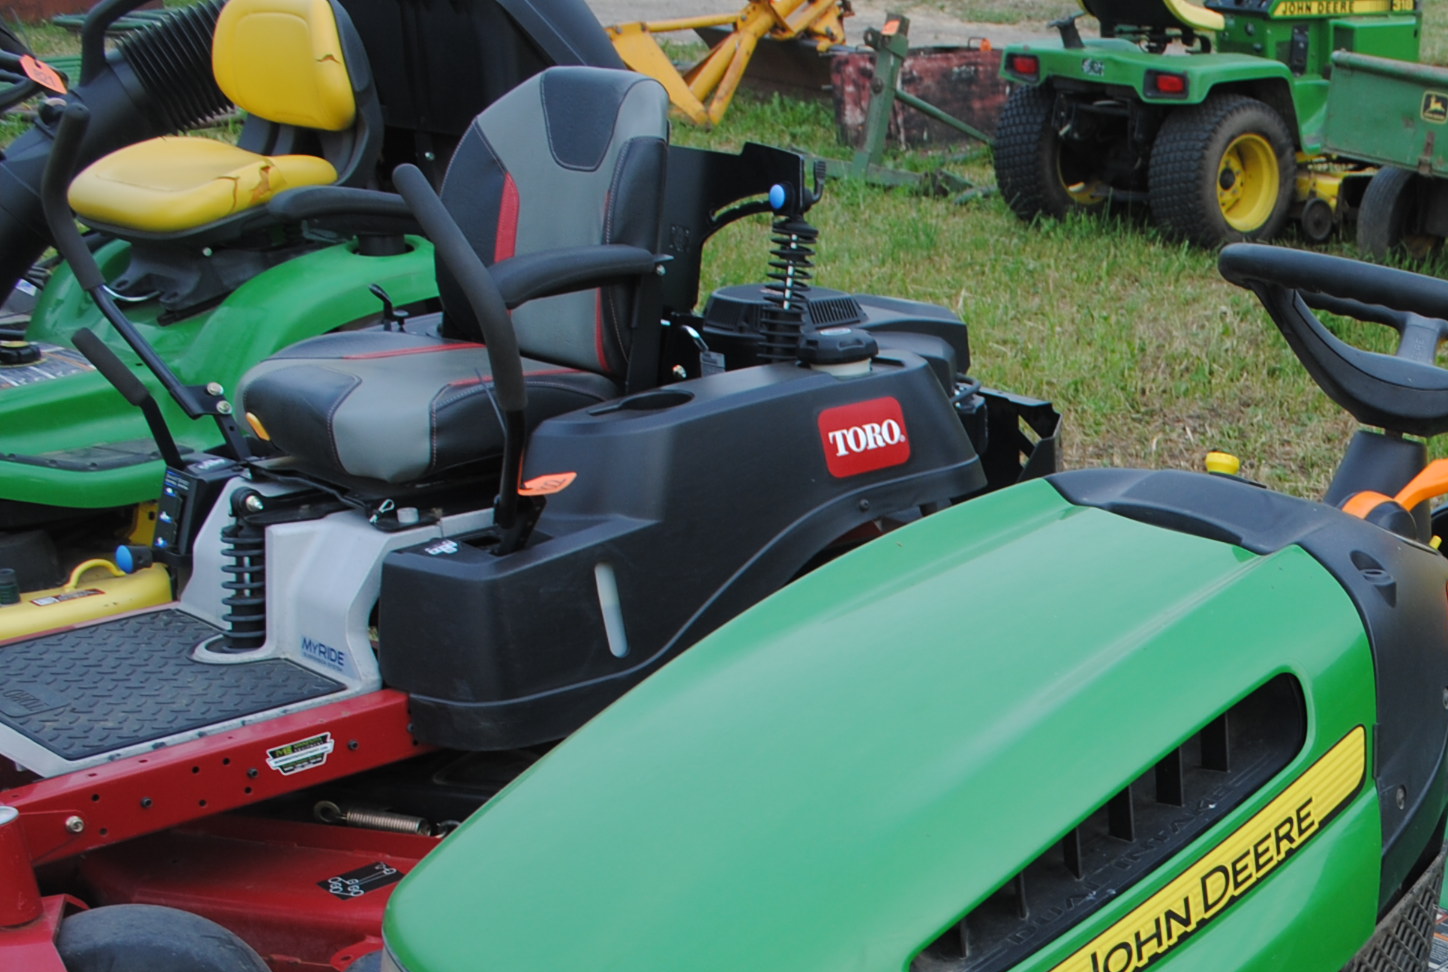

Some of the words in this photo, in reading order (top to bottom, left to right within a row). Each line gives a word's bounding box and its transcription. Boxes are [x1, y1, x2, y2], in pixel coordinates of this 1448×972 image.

[1281, 1, 1311, 15] JOHN
[1317, 0, 1354, 14] DEERE
[828, 418, 902, 456] TORO
[1200, 796, 1317, 915] DEERE
